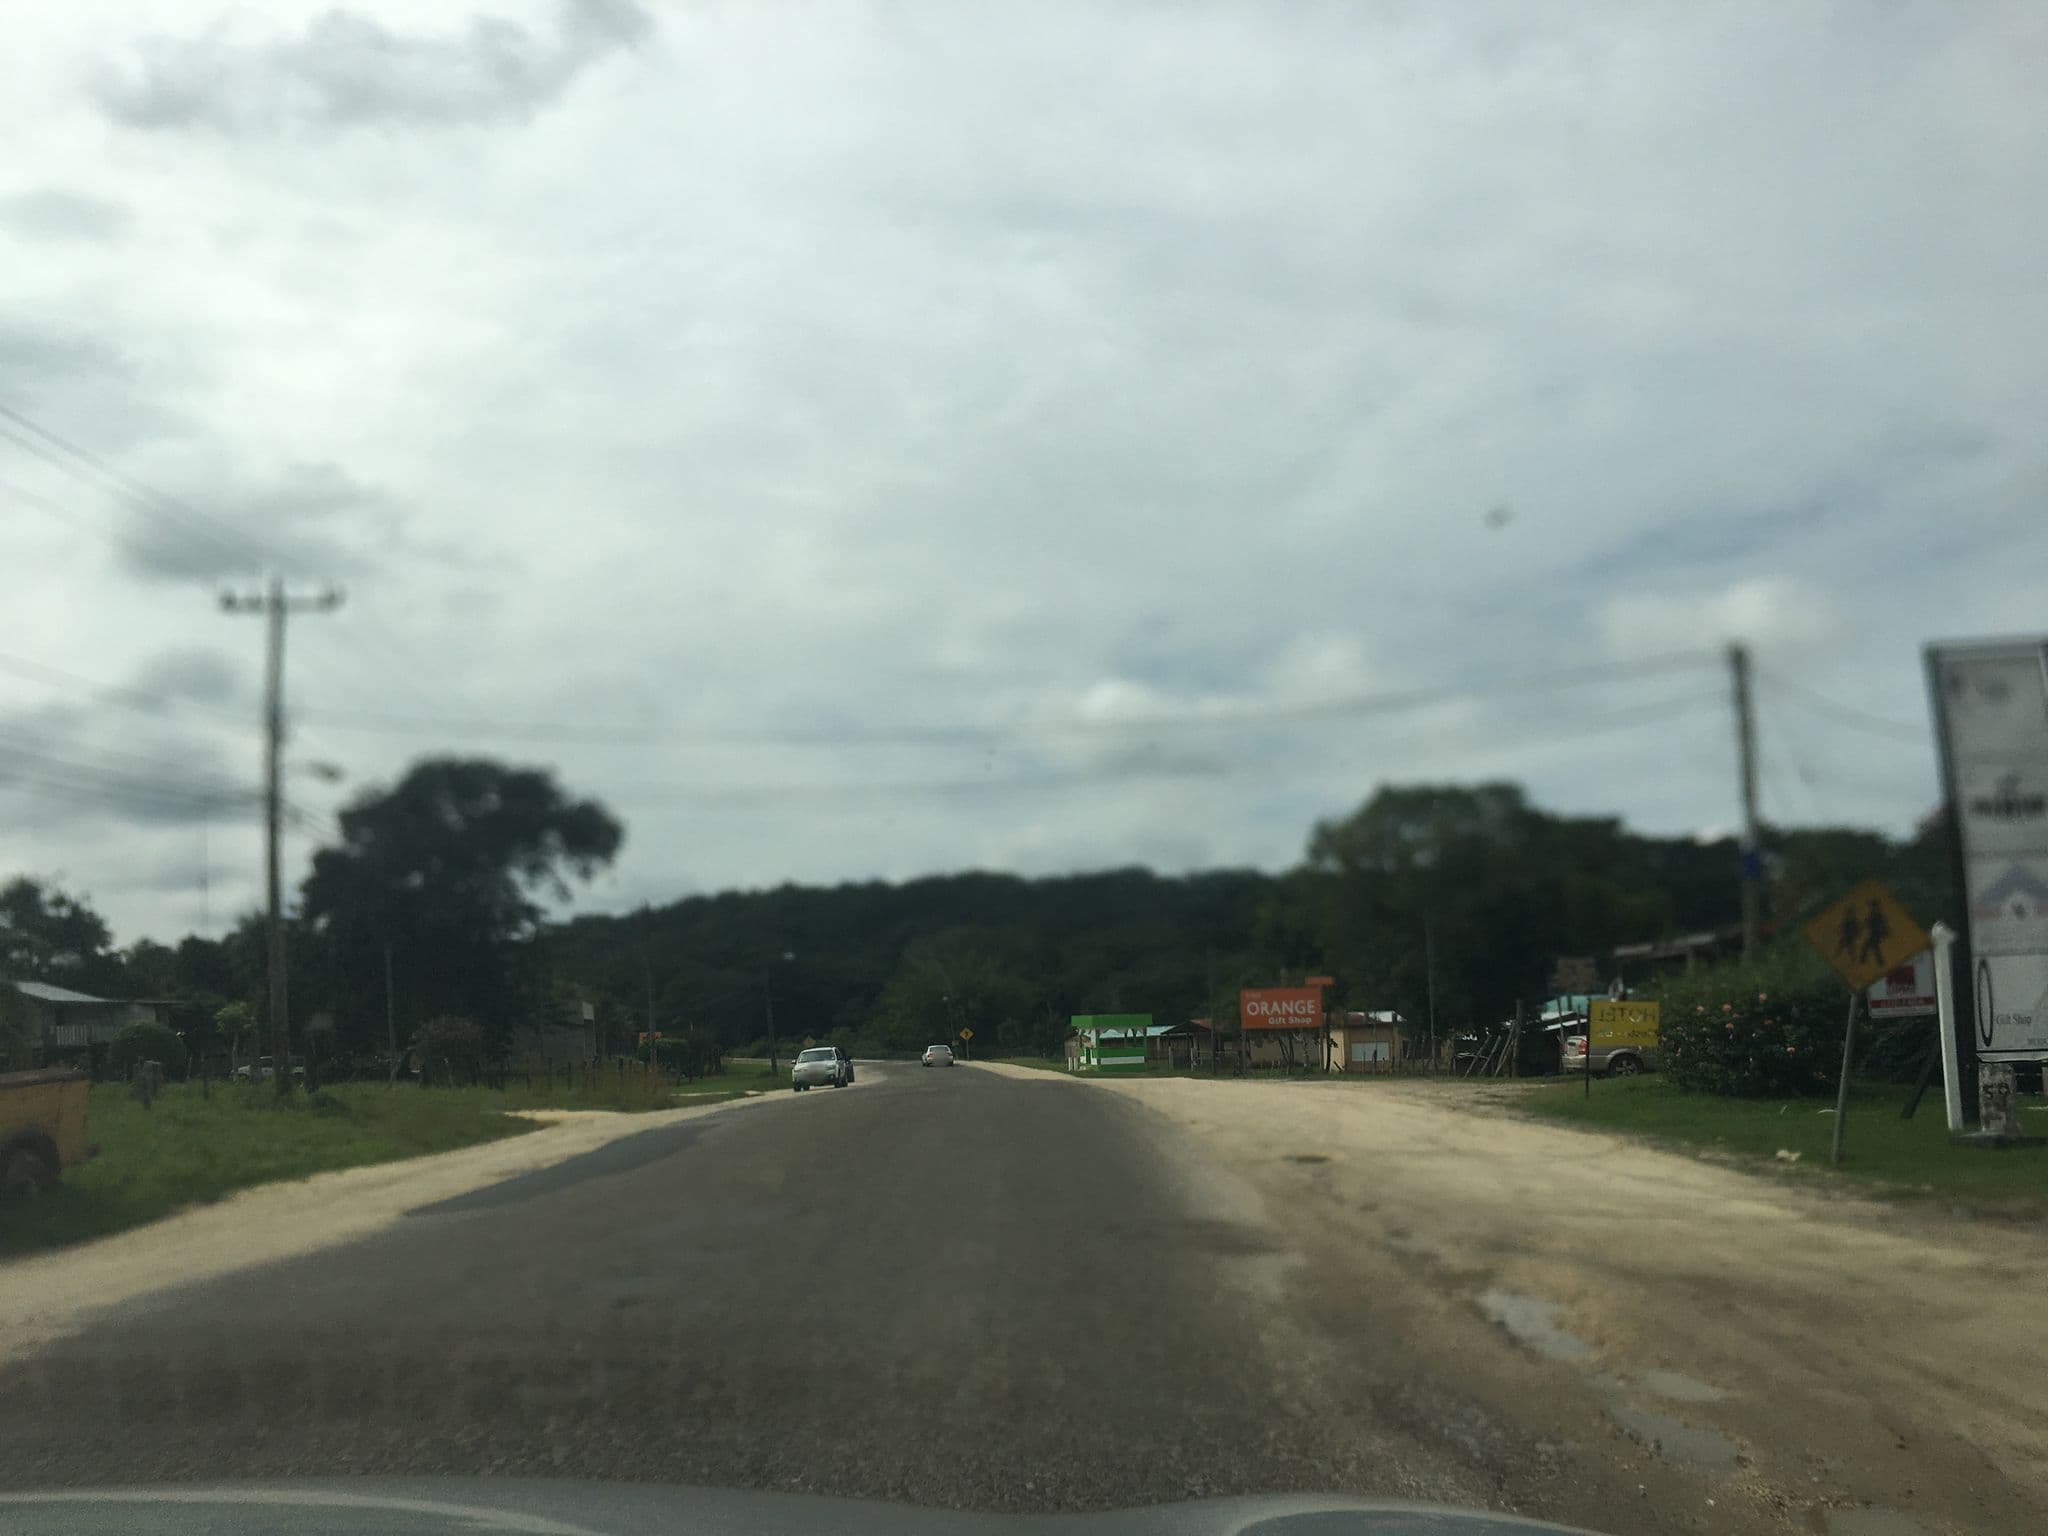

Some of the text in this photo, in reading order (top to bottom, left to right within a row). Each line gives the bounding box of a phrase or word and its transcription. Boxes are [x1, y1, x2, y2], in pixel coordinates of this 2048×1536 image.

[1247, 1000, 1316, 1016] ORANGE
[1268, 1016, 1312, 1025] Gift Shop
